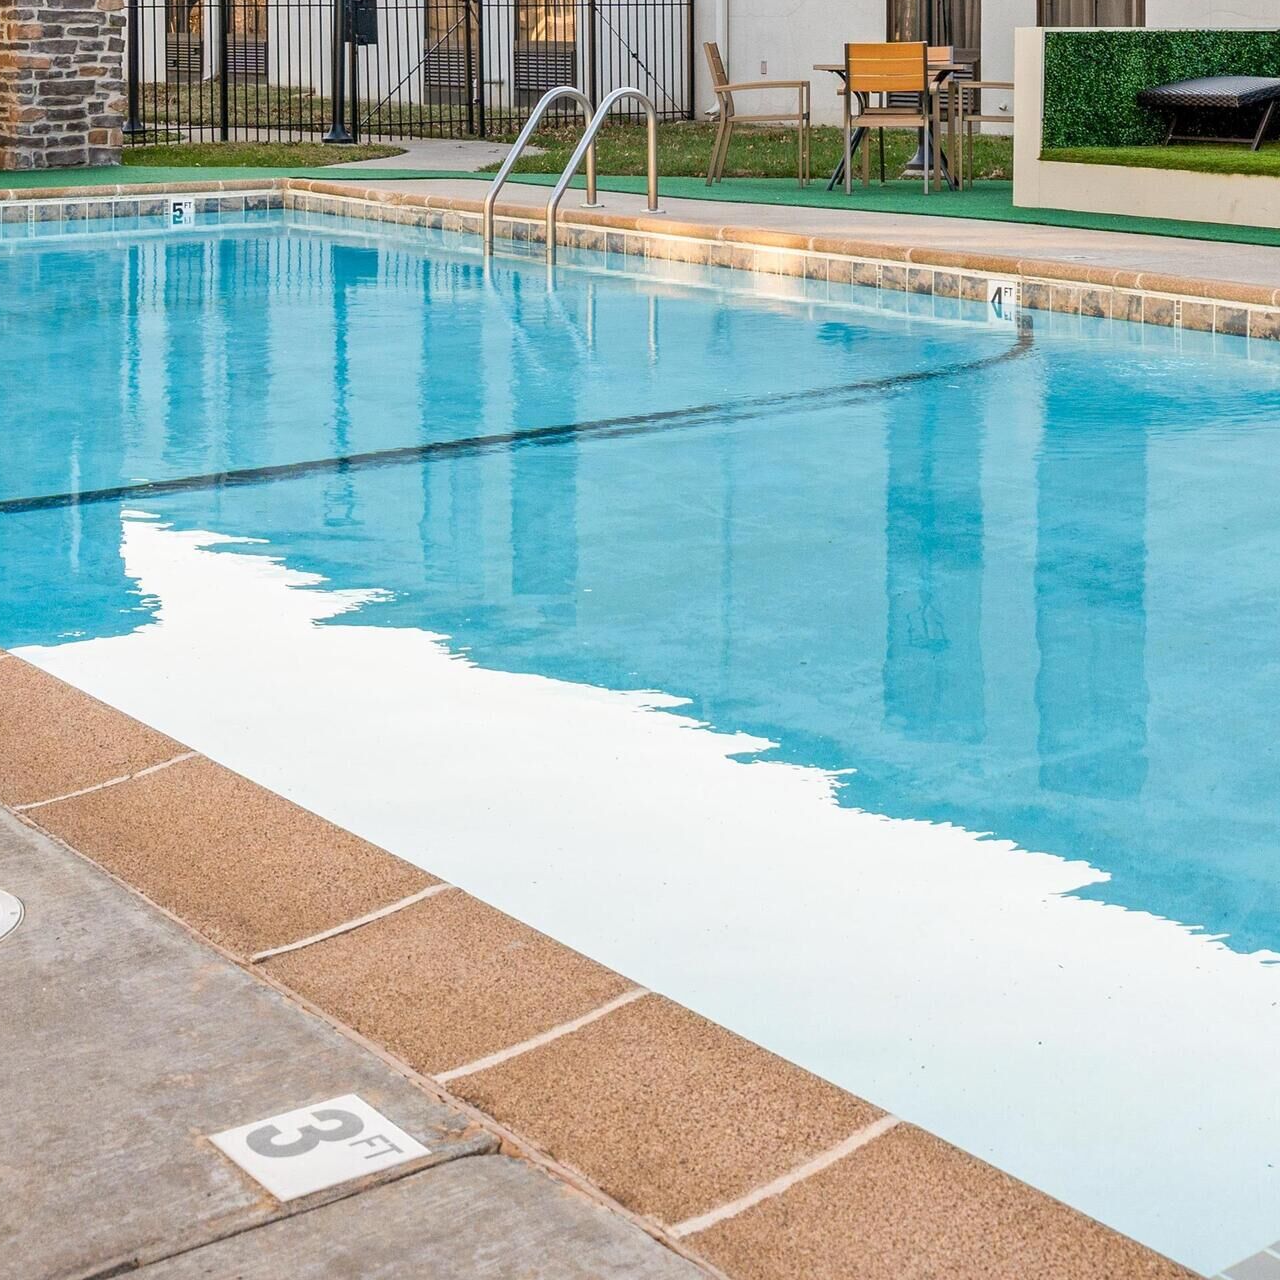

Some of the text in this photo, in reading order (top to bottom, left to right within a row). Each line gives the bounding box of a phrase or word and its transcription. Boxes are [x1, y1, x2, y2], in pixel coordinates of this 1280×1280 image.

[1004, 287, 1013, 297] FT
[246, 1109, 404, 1160] 3 FT
